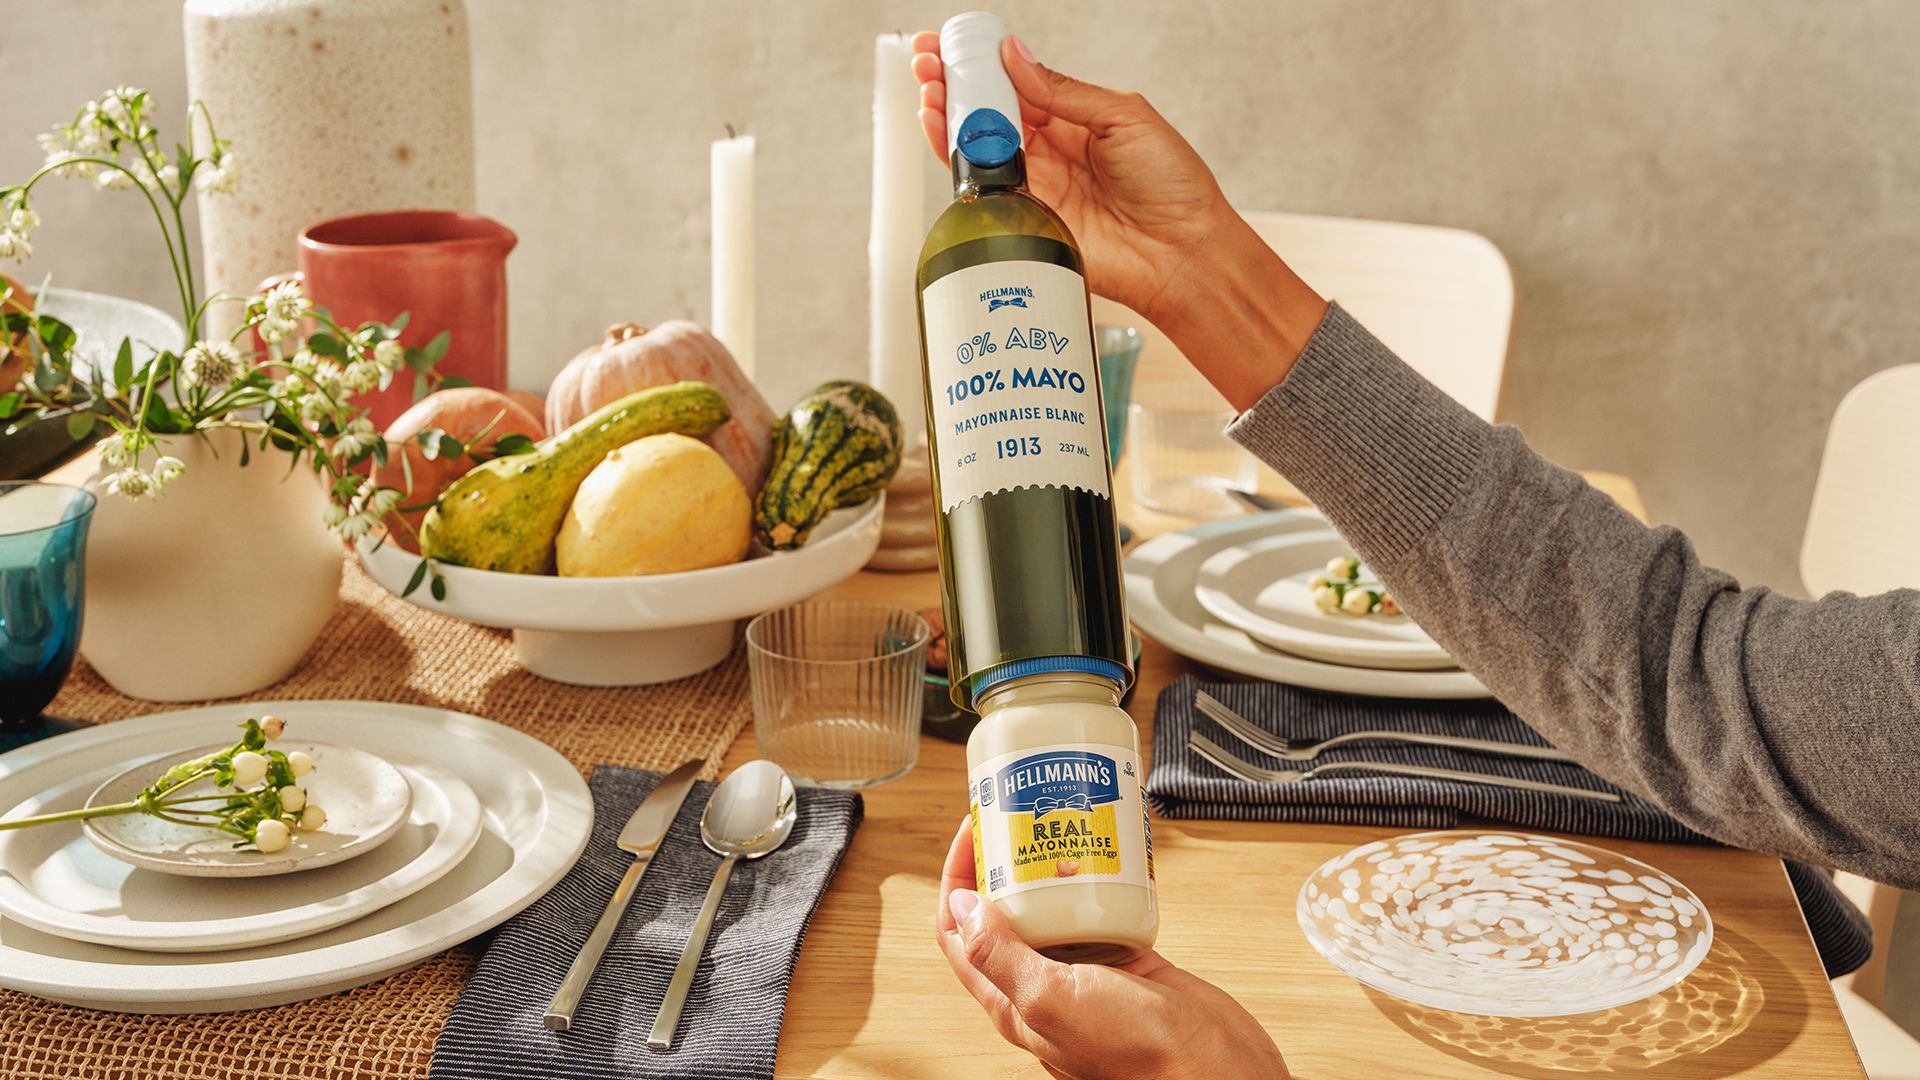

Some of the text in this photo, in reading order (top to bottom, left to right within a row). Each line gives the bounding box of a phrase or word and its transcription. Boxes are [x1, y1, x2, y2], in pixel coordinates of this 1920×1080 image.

[980, 286, 1034, 301] HELLMANN'S
[957, 326, 1069, 365] 0% ABV
[946, 366, 1086, 406] 100% MAYO
[954, 407, 1086, 436] MAYONNAISE BLANC
[996, 436, 1042, 460] 1913
[1059, 442, 1090, 458] 237 ML
[957, 452, 977, 468] 8 OZ
[1004, 760, 1111, 797] HELLMANN'S
[1042, 785, 1077, 794] EST.1913
[1033, 819, 1093, 841] REAL
[1013, 848, 1118, 867] Made with 100% Cage Free Eggs
[1018, 837, 1112, 857] MAYONNAISE
